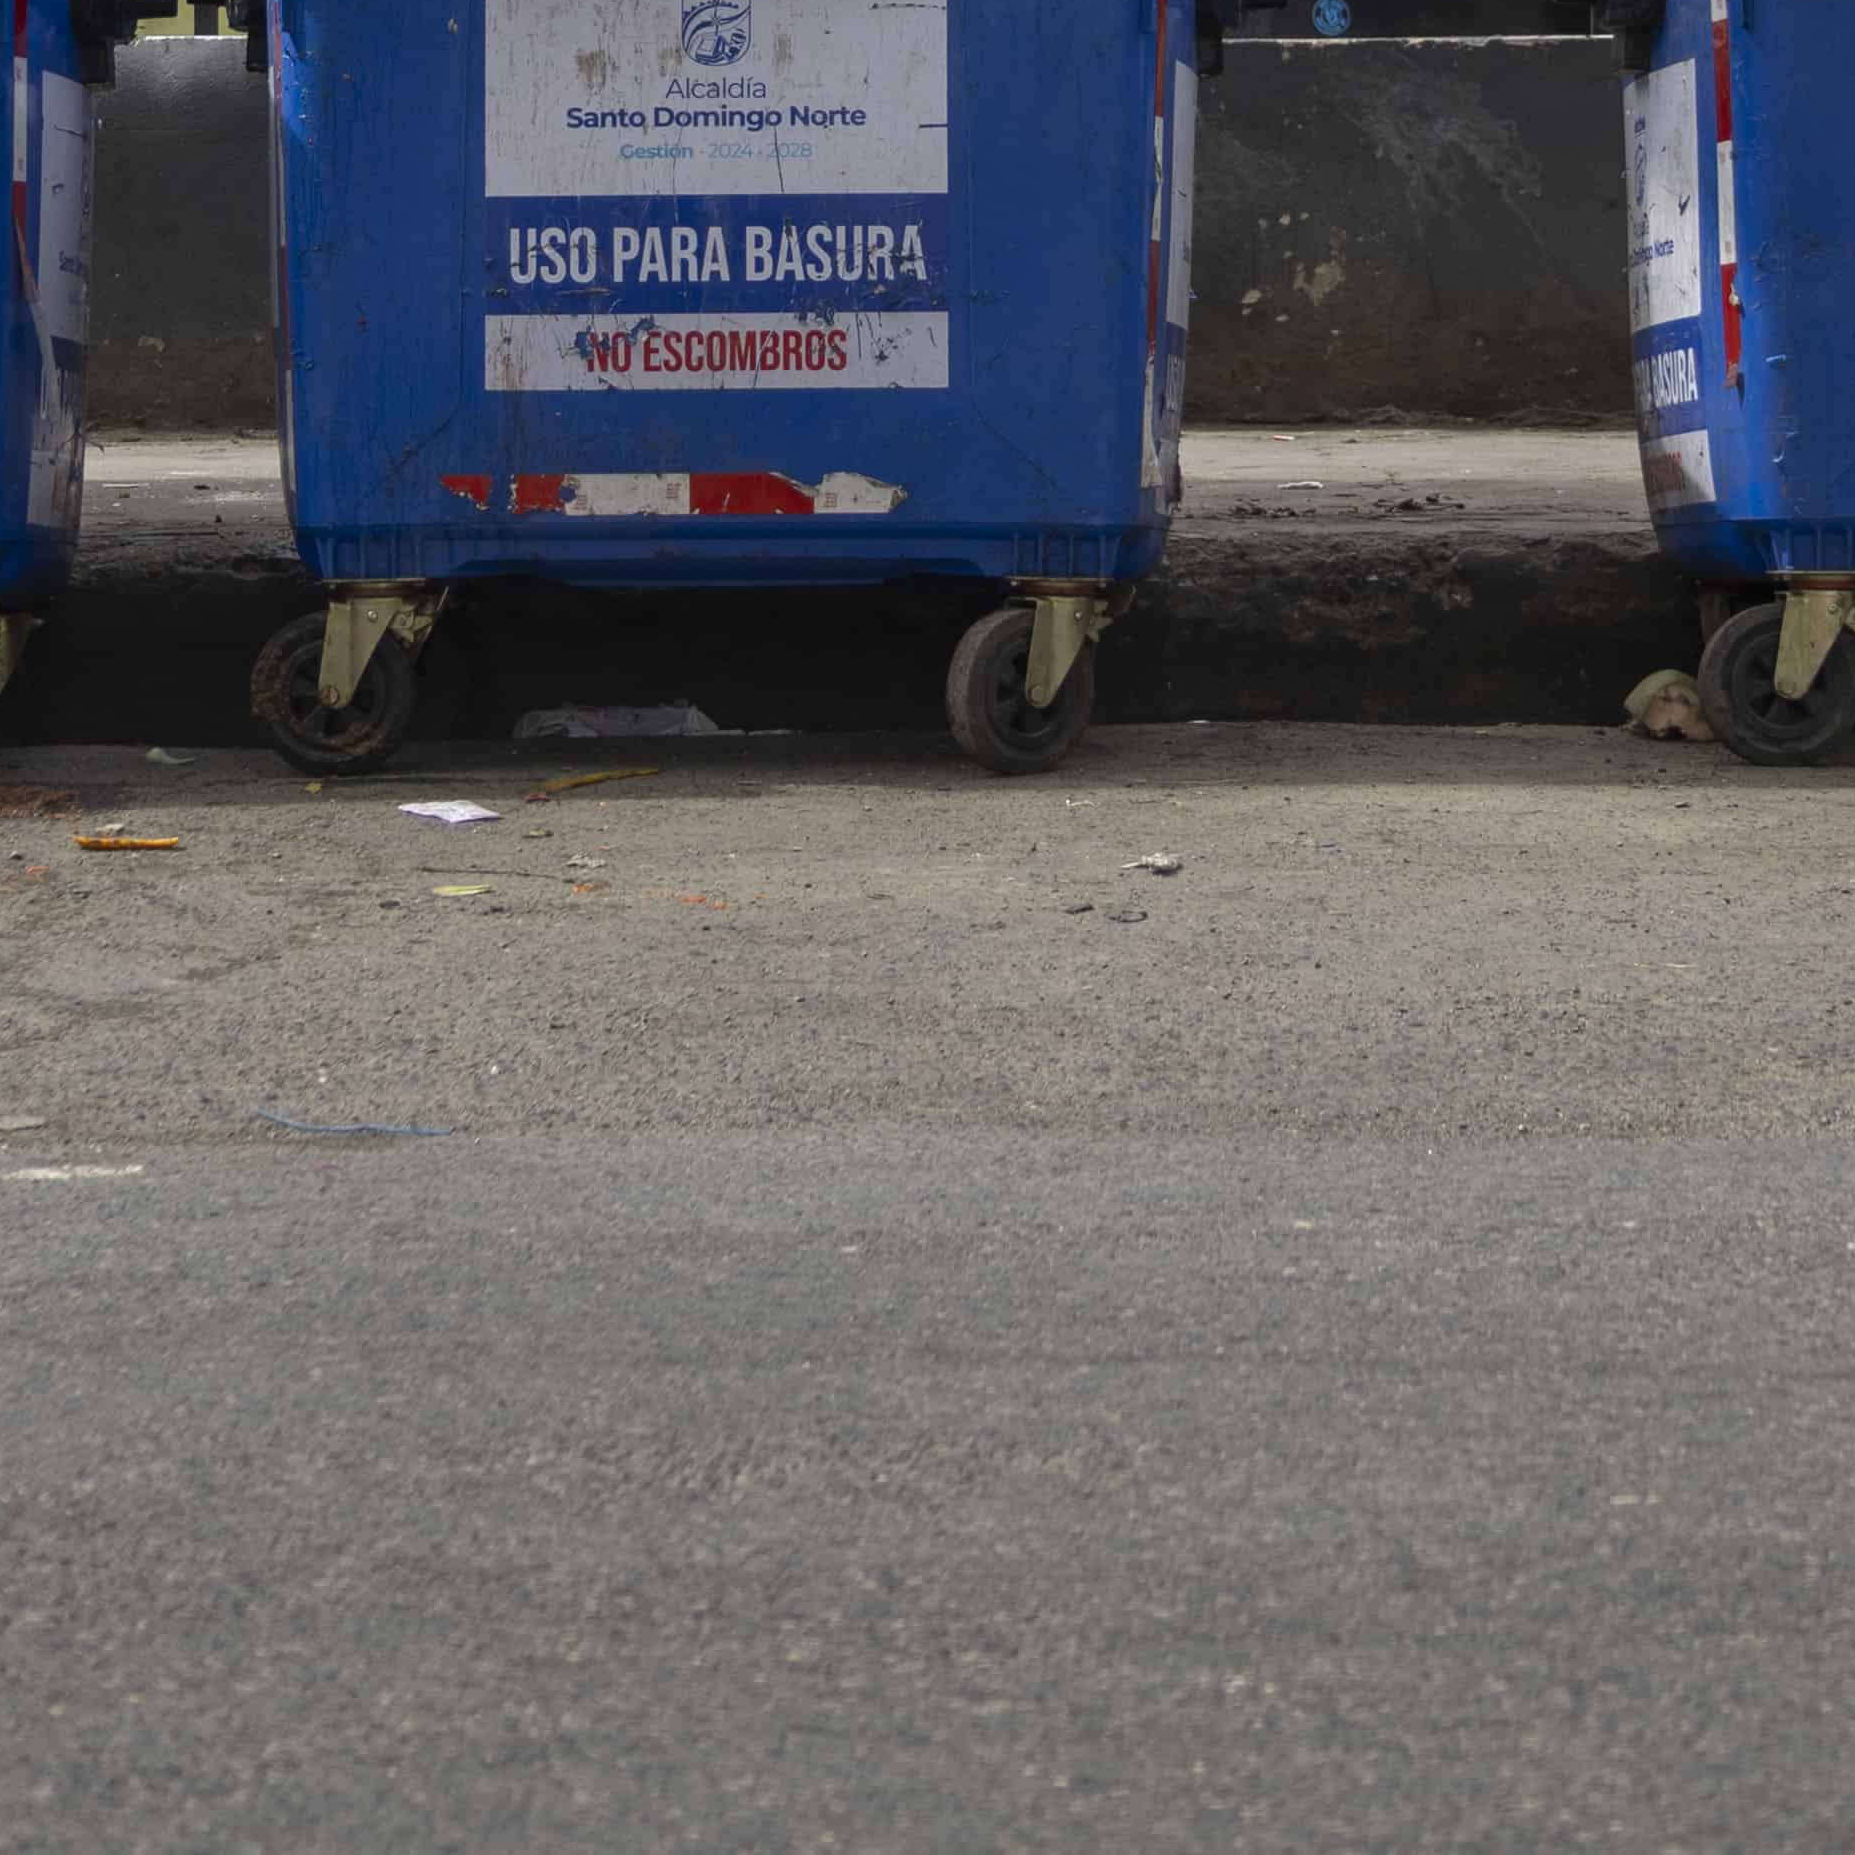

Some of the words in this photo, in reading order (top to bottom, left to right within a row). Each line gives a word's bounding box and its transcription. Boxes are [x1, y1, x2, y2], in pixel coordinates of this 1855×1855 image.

[665, 77, 768, 99] Alcaldía
[566, 107, 646, 129] Santo
[654, 105, 783, 132] Domingo
[790, 105, 867, 128] Norte
[619, 142, 693, 159] Gestión
[707, 142, 753, 159] 2024
[766, 142, 813, 159] 2028
[509, 227, 597, 284] USO
[613, 226, 731, 283] PARA
[745, 224, 928, 283] BASURA
[586, 331, 632, 373] NO
[643, 329, 847, 372] ESCOMBROS
[1651, 346, 1699, 408] BASURA
